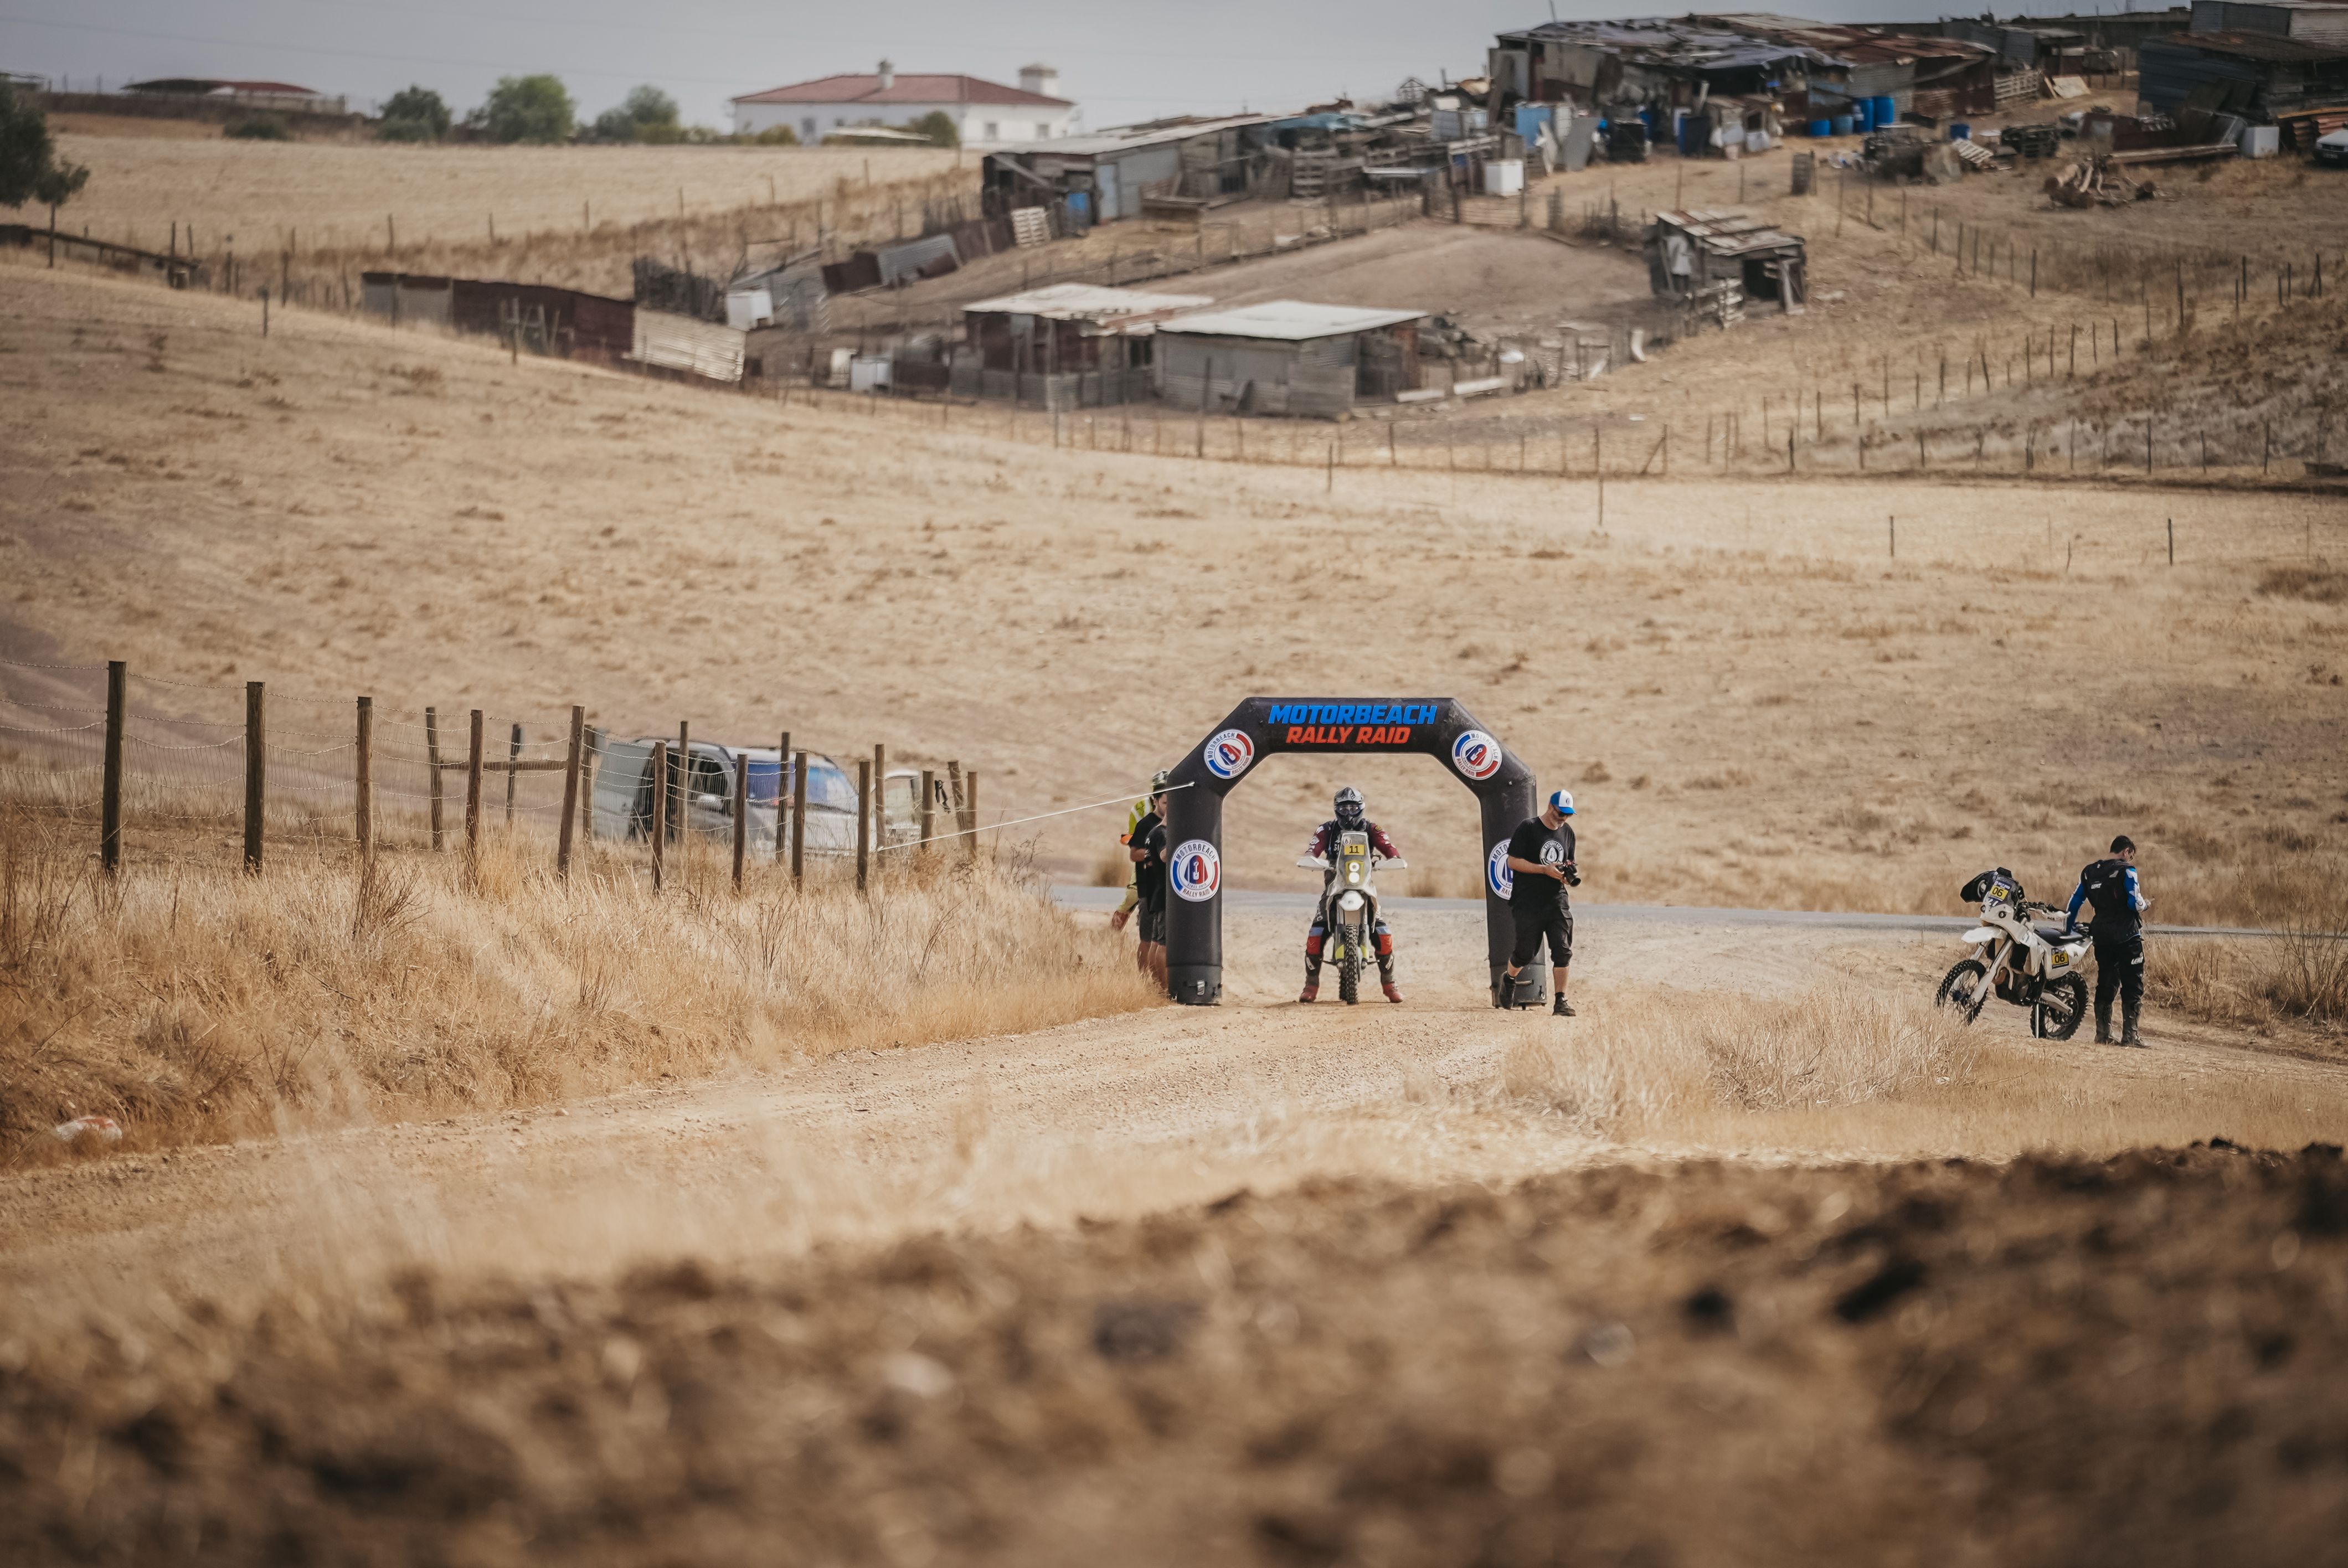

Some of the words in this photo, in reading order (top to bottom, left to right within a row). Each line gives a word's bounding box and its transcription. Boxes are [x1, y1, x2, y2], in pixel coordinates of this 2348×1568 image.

[1268, 705, 1438, 725] MOTORBEACH
[1285, 726, 1354, 744] RALLY
[1356, 726, 1411, 744] RAID
[1207, 732, 1235, 759] MOTORBEACH
[1176, 843, 1216, 861] MOTORBEACH
[1348, 845, 1360, 854] 11
[1182, 888, 1198, 898] RALLY
[1992, 887, 2004, 897] 06
[2054, 953, 2065, 963] 06
